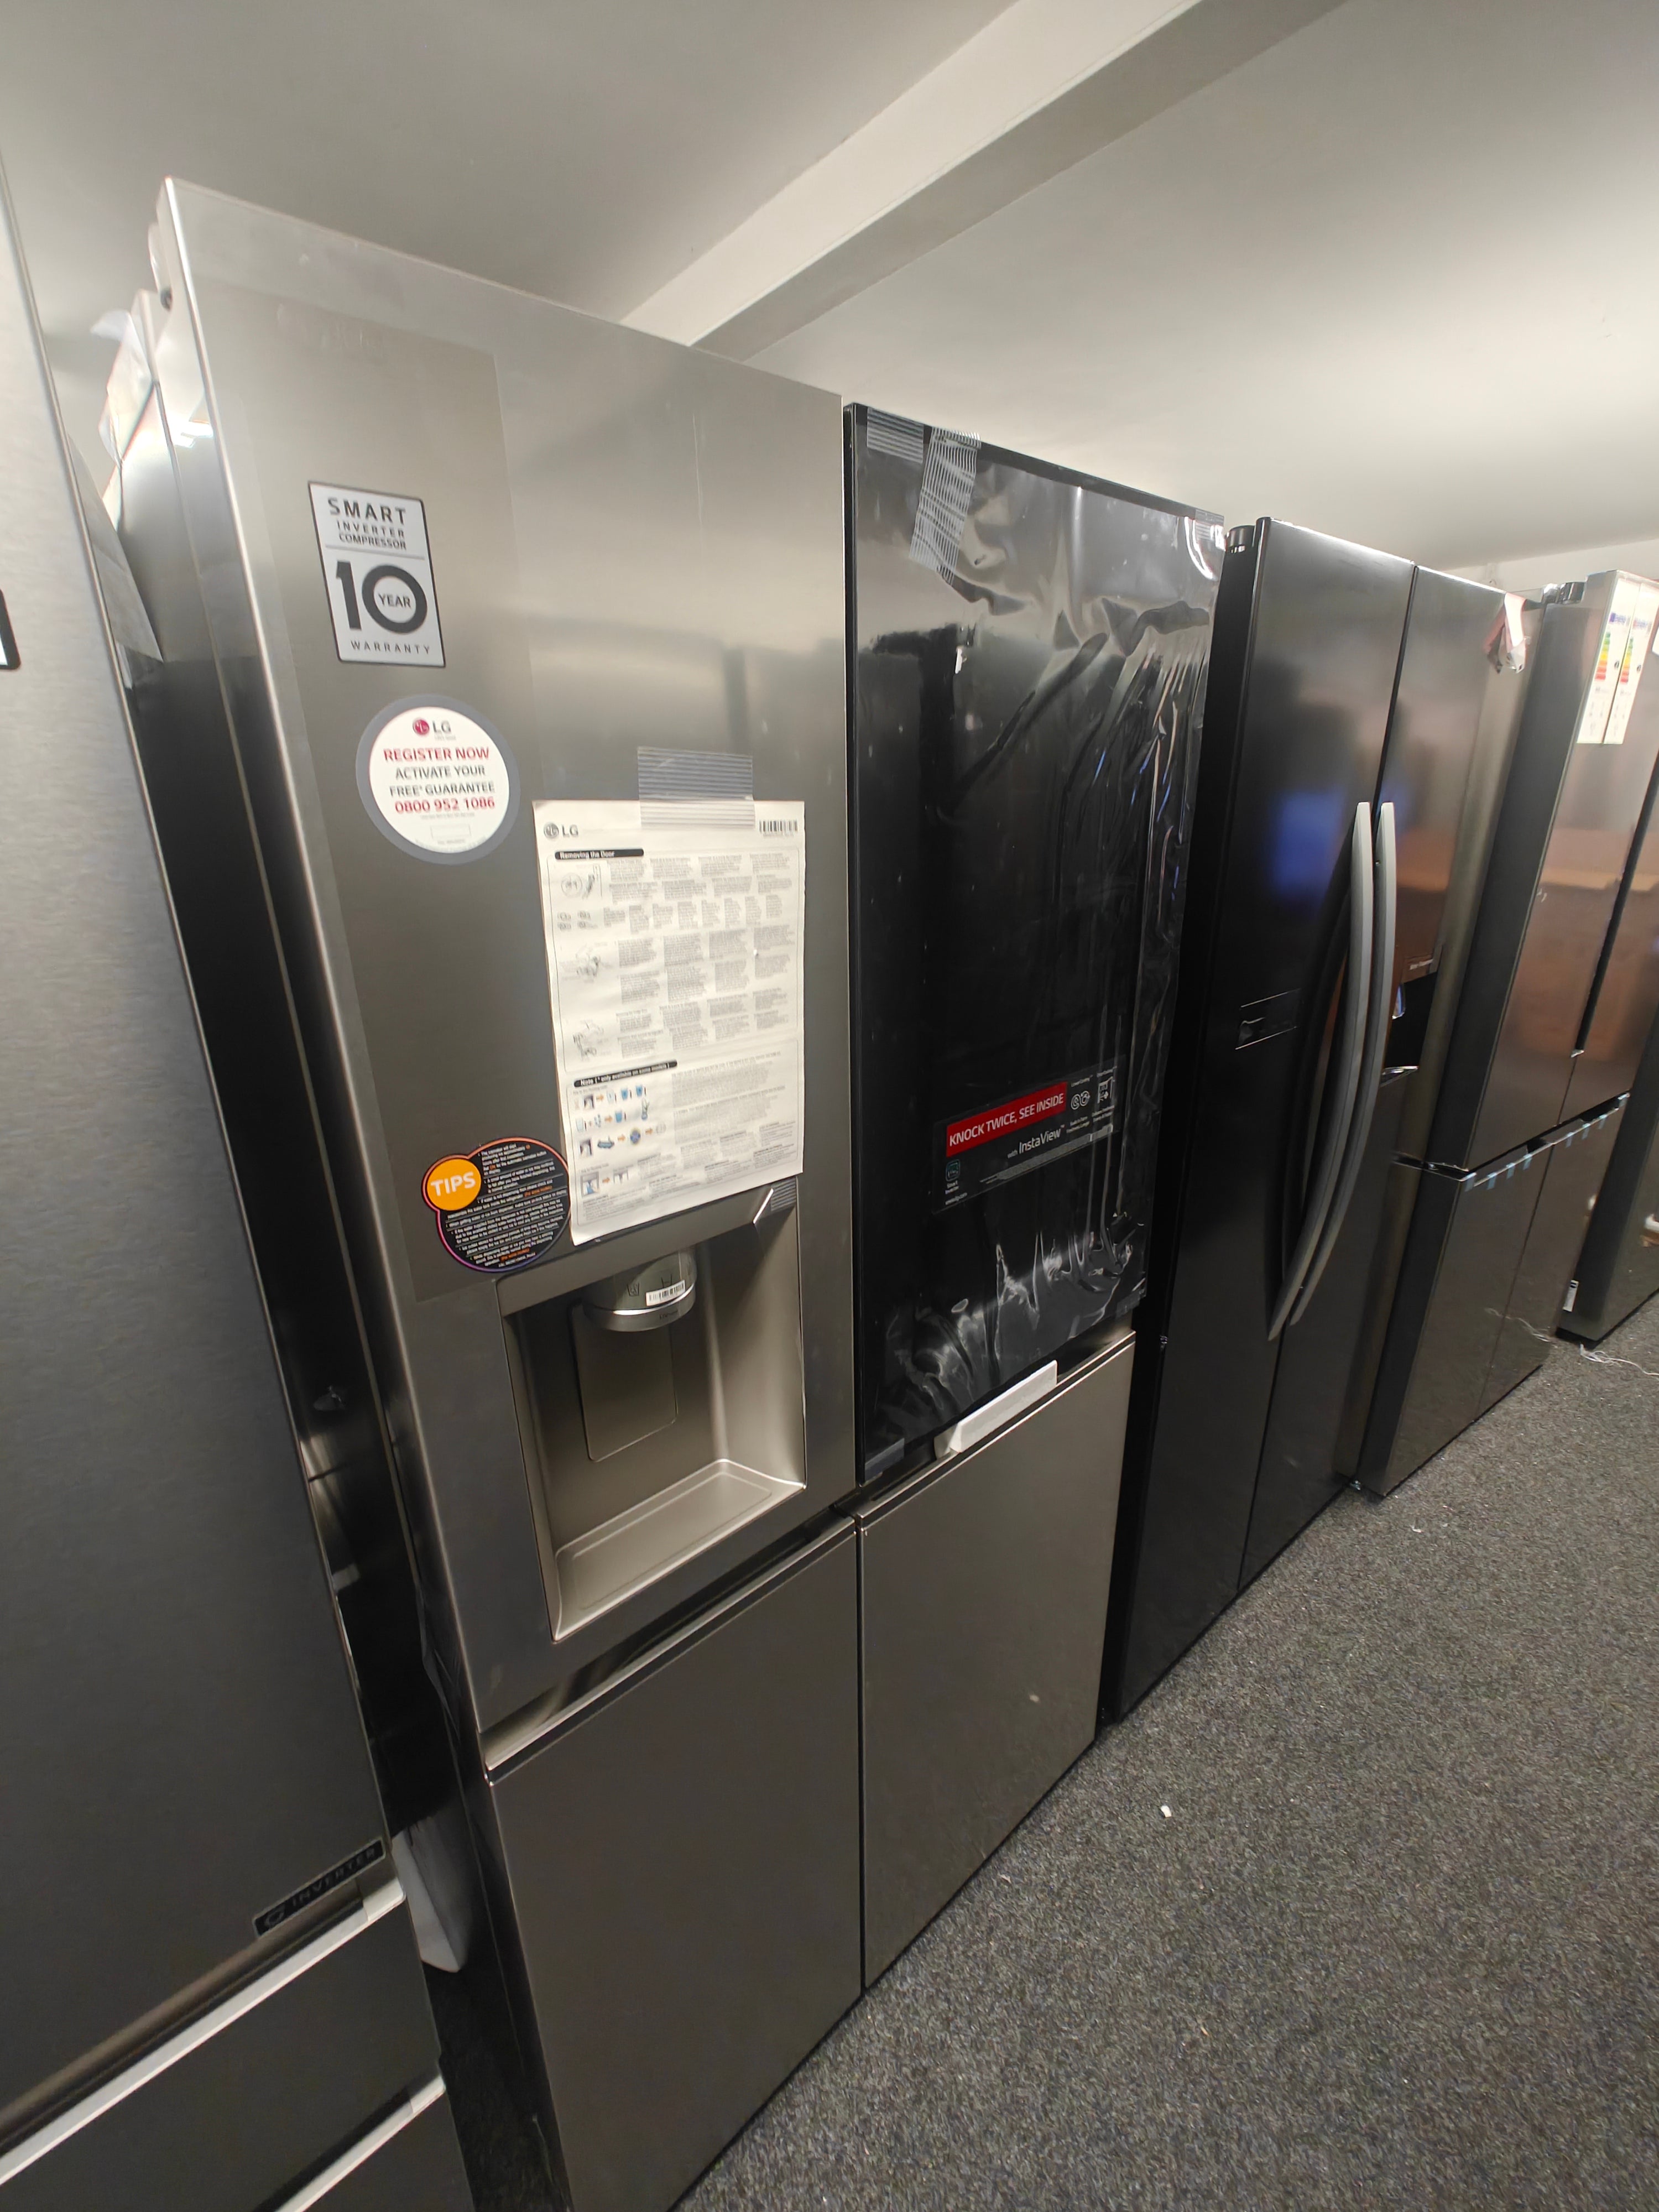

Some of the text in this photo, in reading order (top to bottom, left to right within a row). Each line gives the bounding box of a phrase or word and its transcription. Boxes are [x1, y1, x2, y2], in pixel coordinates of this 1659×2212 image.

[327, 497, 406, 525] SMART
[337, 520, 405, 538] INVERTER
[338, 533, 407, 550] COMPRESSOR
[336, 560, 428, 635] 10
[378, 593, 412, 609] YEAR
[351, 640, 430, 654] WARRANTY
[432, 720, 451, 734] LG
[383, 747, 489, 763] REGISTER NOW
[395, 764, 486, 780] ACTIVATE YOUR
[425, 781, 495, 796] GUARANTEE
[395, 796, 495, 813] 0800 952 1086
[562, 824, 578, 838] LG
[560, 851, 589, 859] Removing
[949, 1093, 1064, 1147] KNOCK TWICE, SEE INSIDE
[1007, 1149, 1018, 1159] with
[430, 1171, 476, 1196] TIPS
